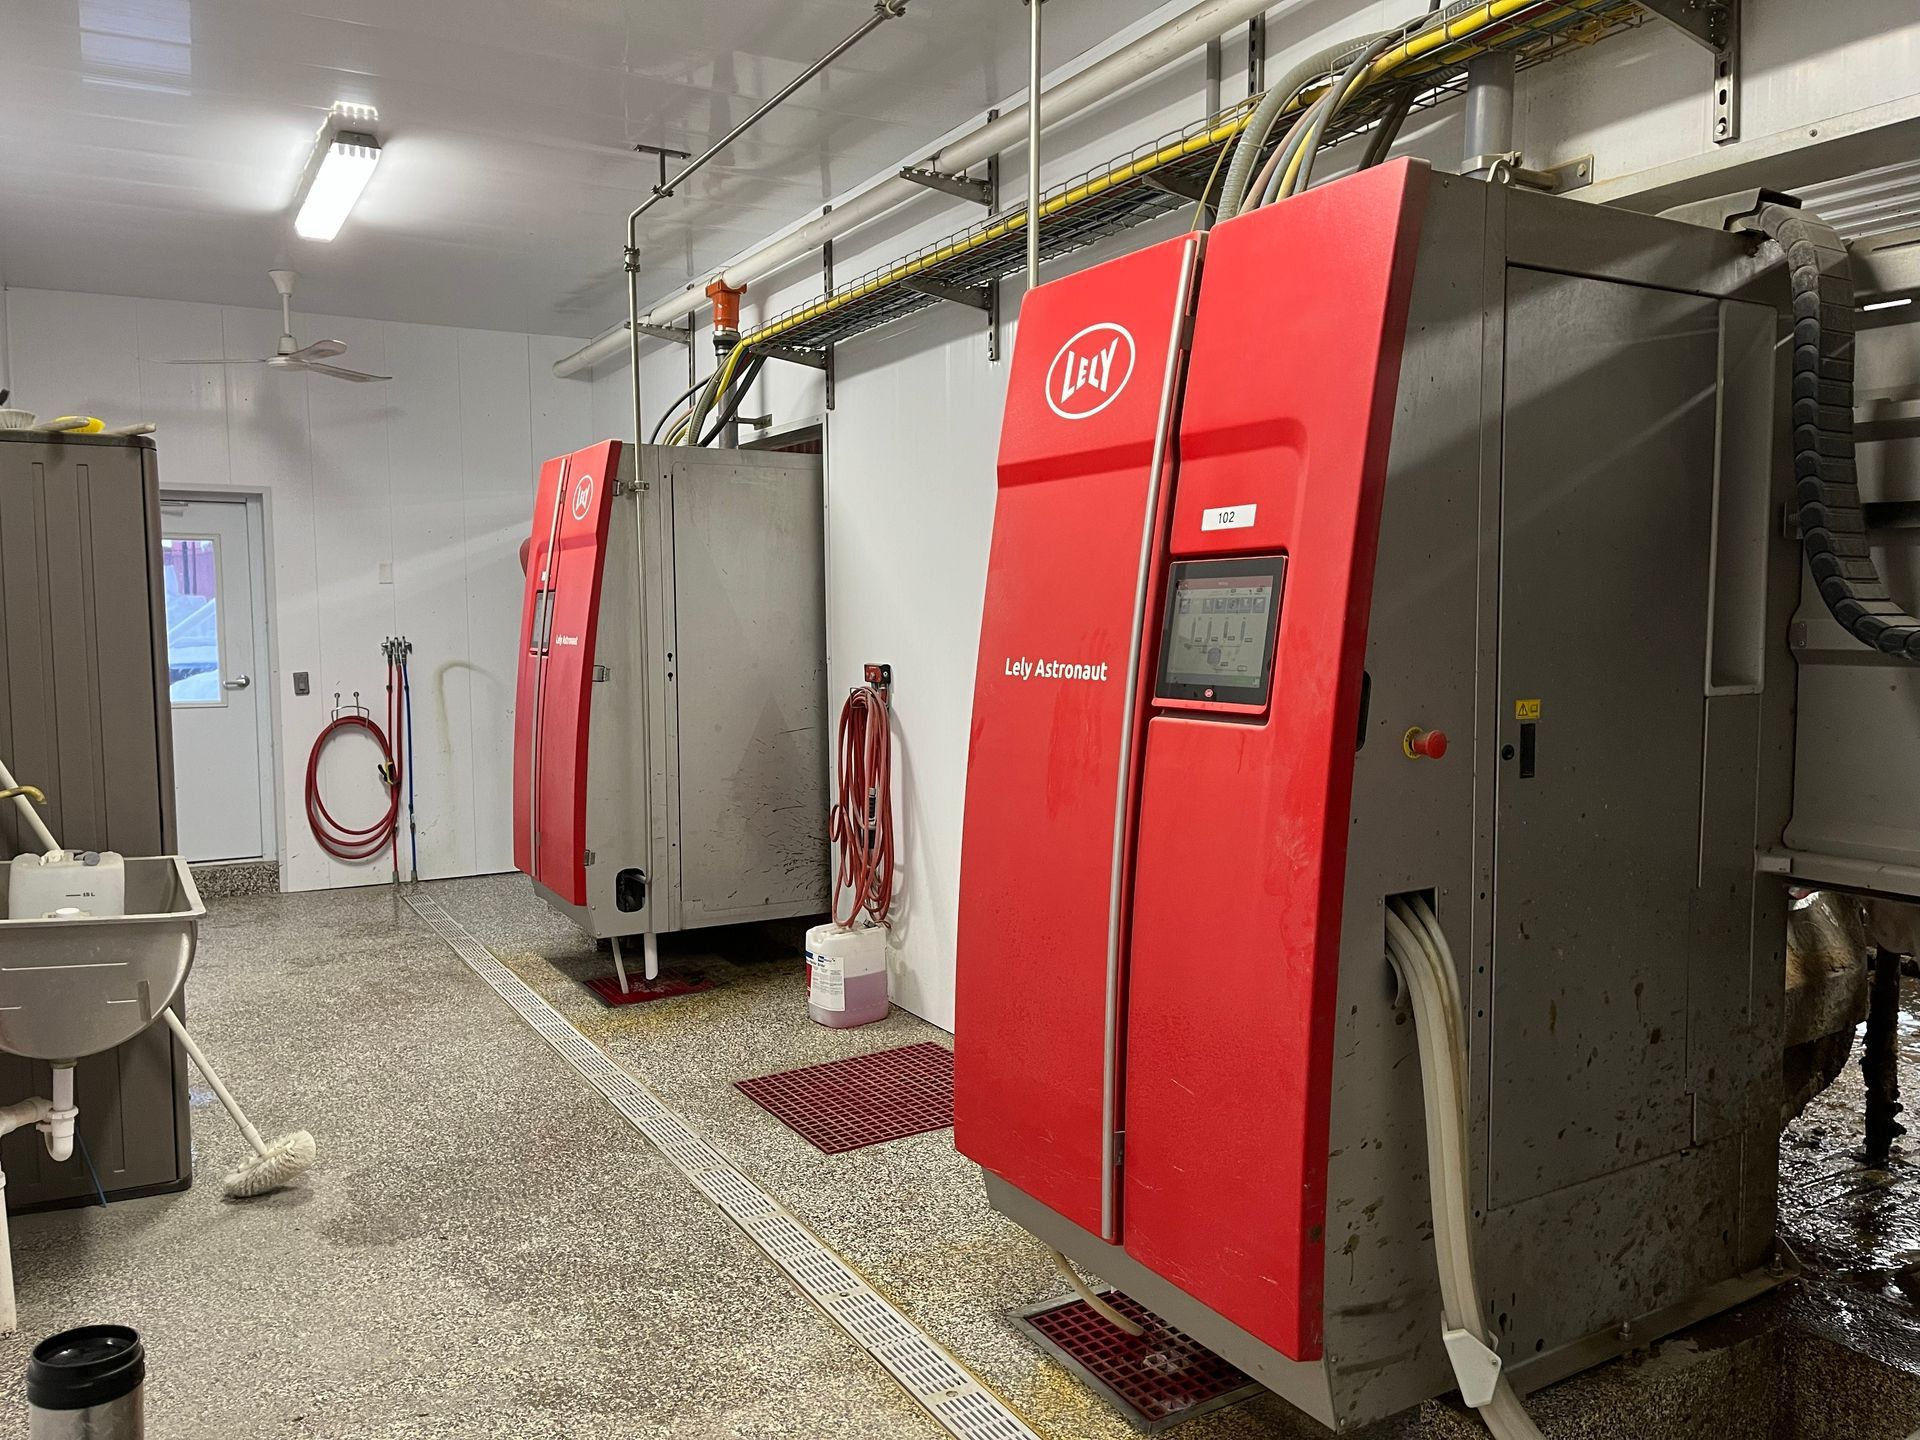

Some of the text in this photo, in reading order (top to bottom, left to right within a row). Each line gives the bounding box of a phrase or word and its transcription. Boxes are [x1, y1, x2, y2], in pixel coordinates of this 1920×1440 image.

[1061, 337, 1119, 404] LELY
[1218, 511, 1235, 524] 102
[1004, 657, 1108, 681] Lely Astronaut
